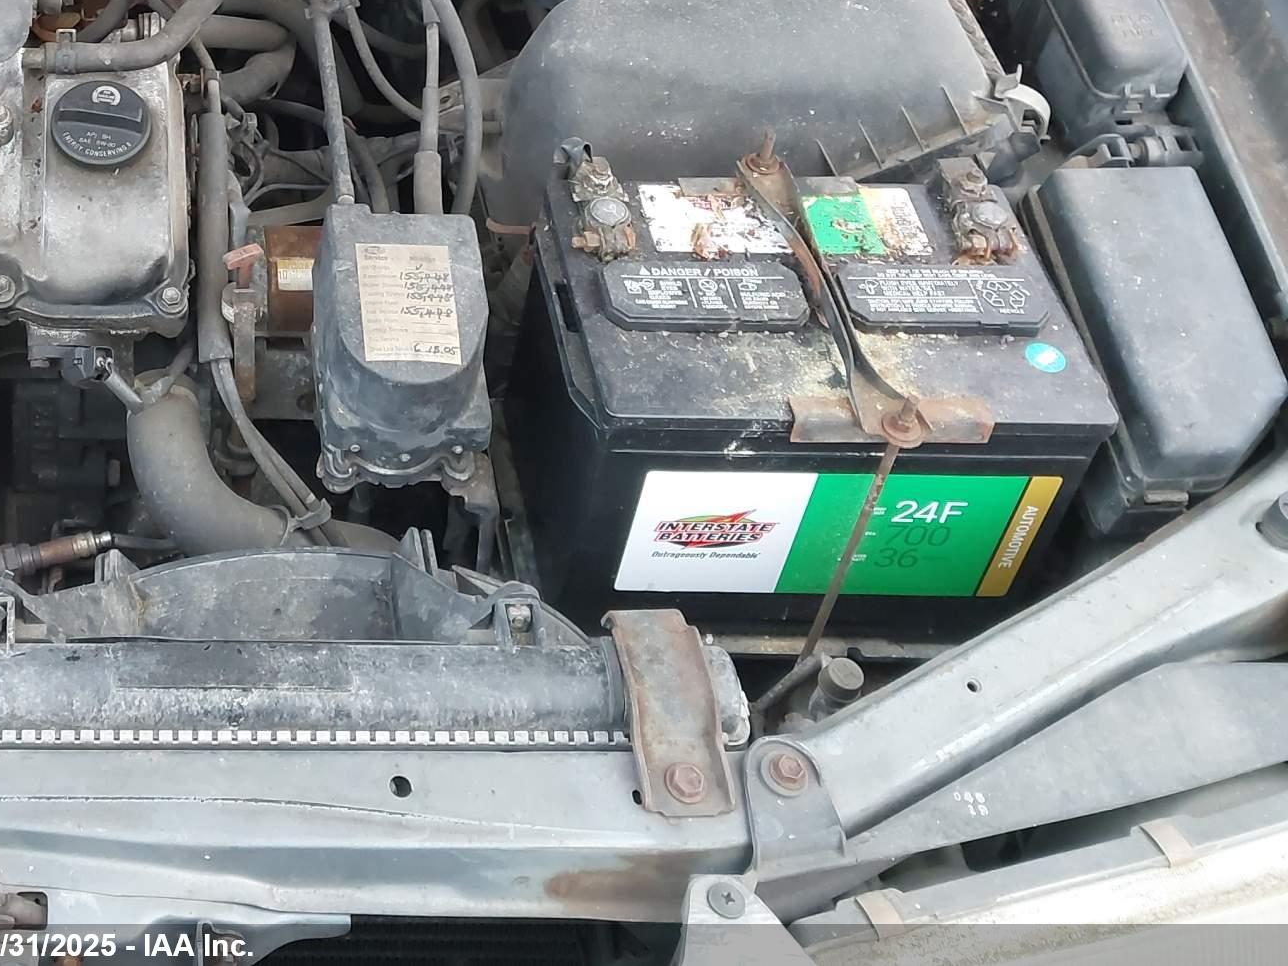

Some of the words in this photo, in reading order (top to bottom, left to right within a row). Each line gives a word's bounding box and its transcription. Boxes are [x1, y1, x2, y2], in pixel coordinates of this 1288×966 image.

[62, 132, 84, 151] ENERGY
[85, 145, 127, 157] CONSERVING
[651, 268, 702, 276] DANGER
[714, 268, 759, 277] POISON
[890, 500, 969, 524] 24F
[658, 523, 774, 532] INTERSTATE
[658, 533, 761, 541] BATTERIES
[884, 525, 951, 547] 700
[998, 505, 1039, 569] AUTOMOTIVE
[651, 551, 708, 560] Outrageously
[873, 547, 919, 568] 36
